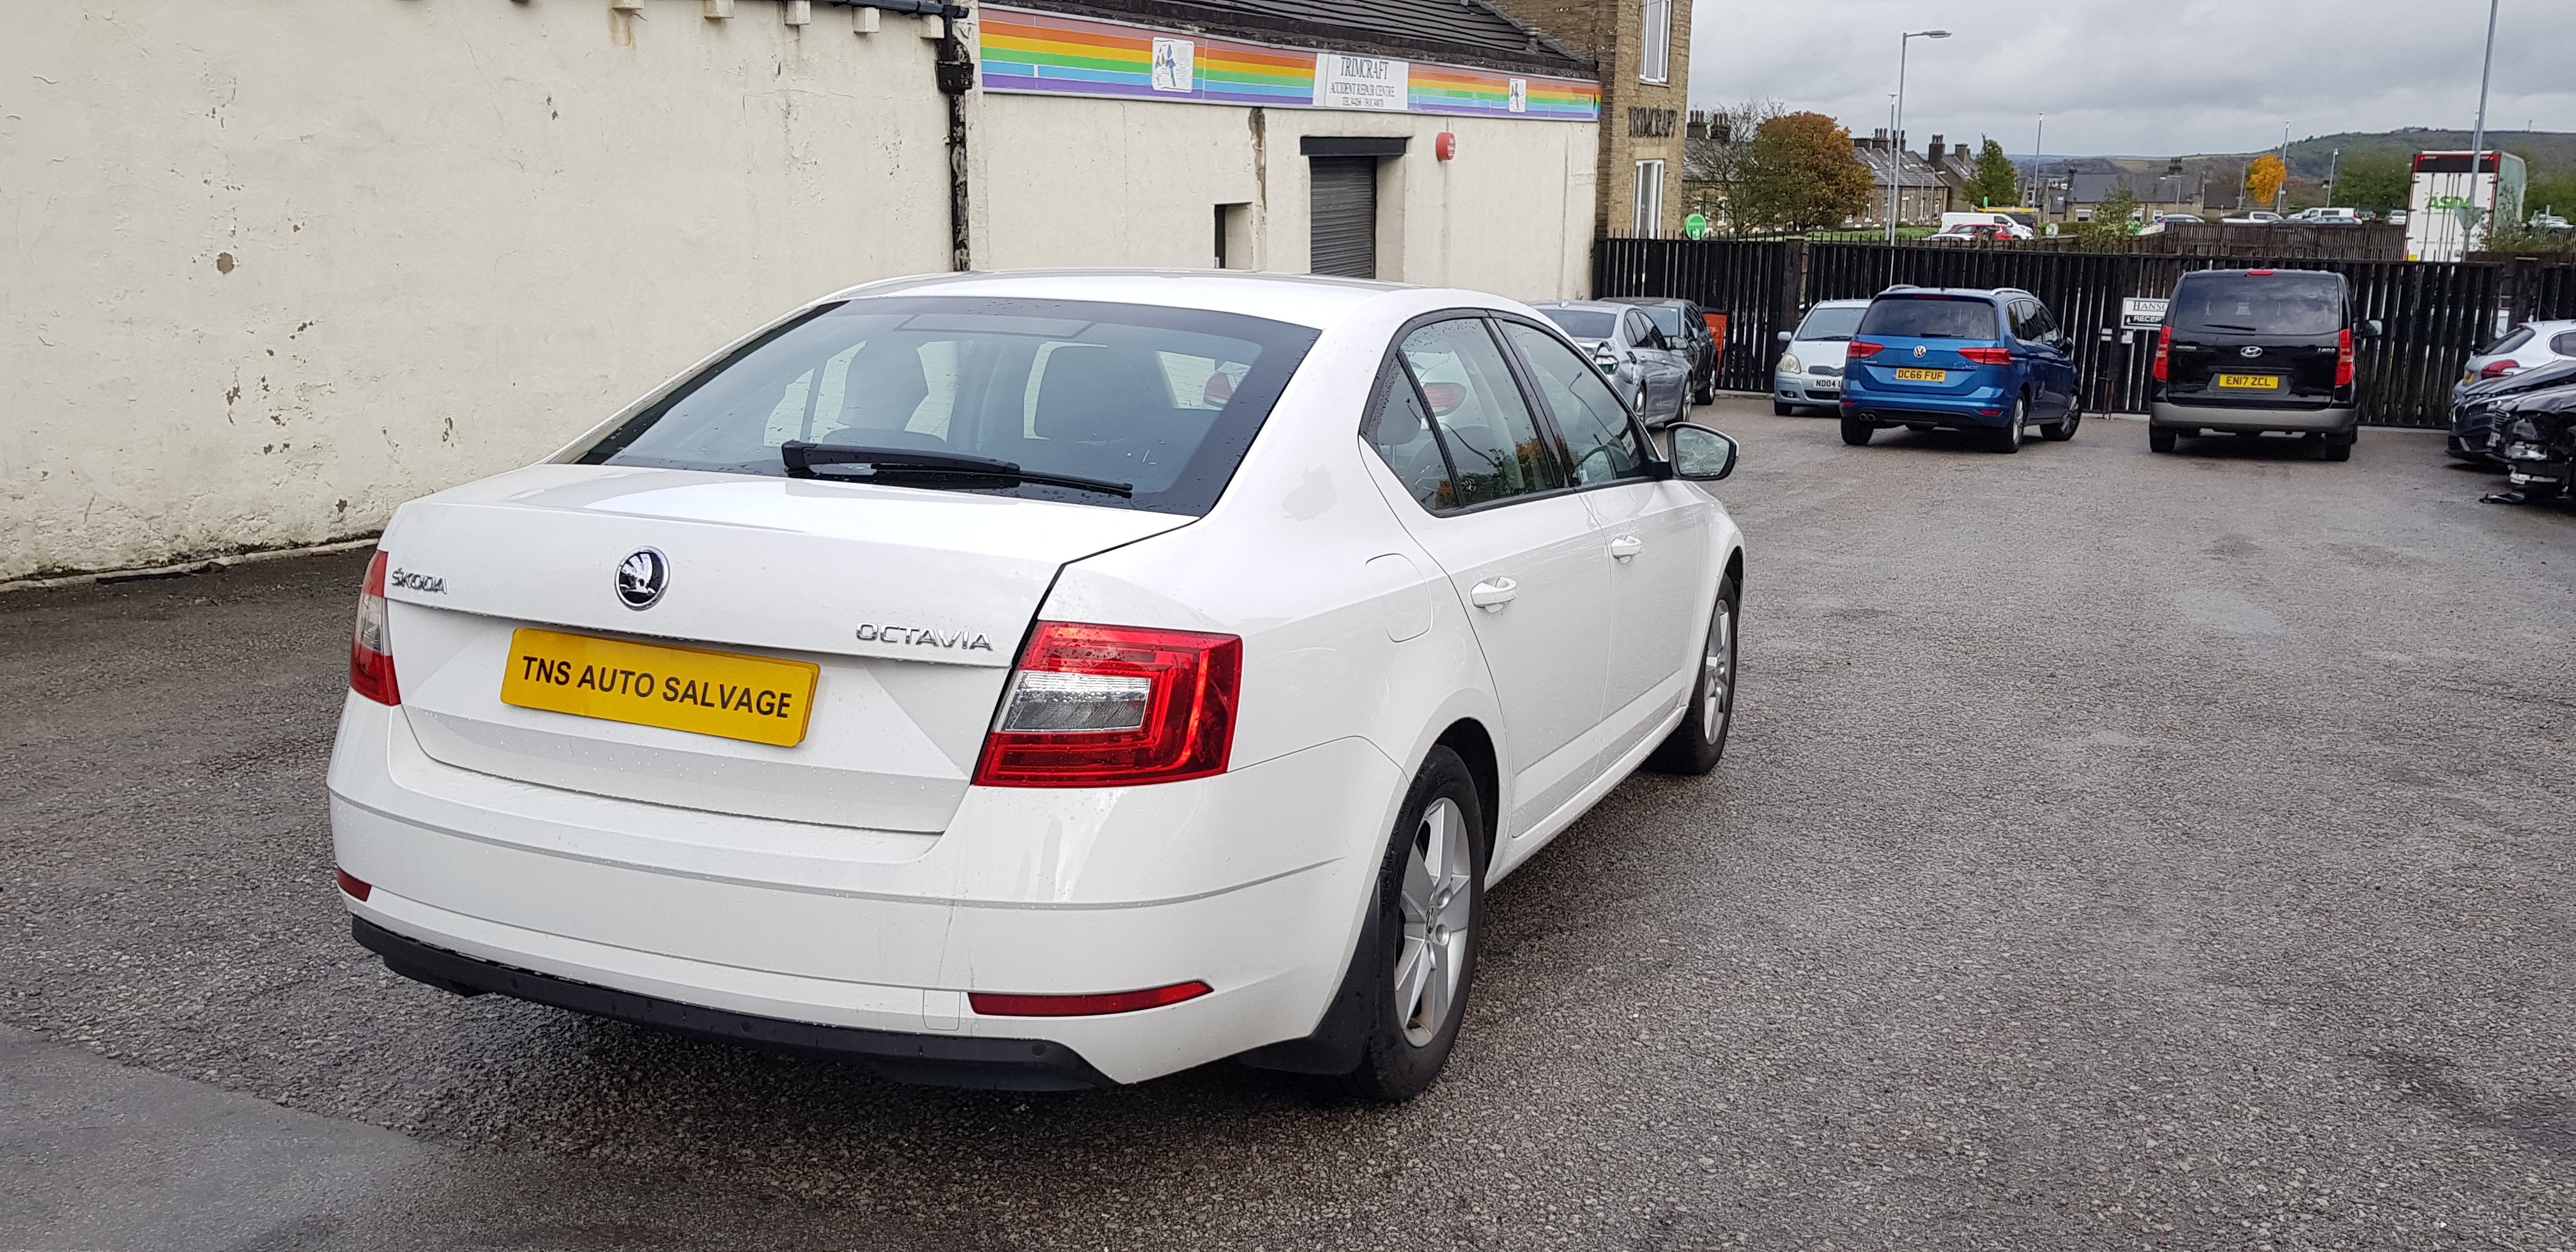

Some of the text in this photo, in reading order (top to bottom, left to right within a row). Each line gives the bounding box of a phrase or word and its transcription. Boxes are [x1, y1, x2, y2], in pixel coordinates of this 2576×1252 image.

[1340, 57, 1389, 79] TRIMCRAFT
[1897, 370, 1943, 380] DC66 FUF
[2226, 376, 2271, 386] EN17 ZCL
[1816, 379, 1836, 388] ND04
[856, 622, 993, 651] OCTAVIA
[522, 655, 792, 719] TNS AUTO SALVAGE
